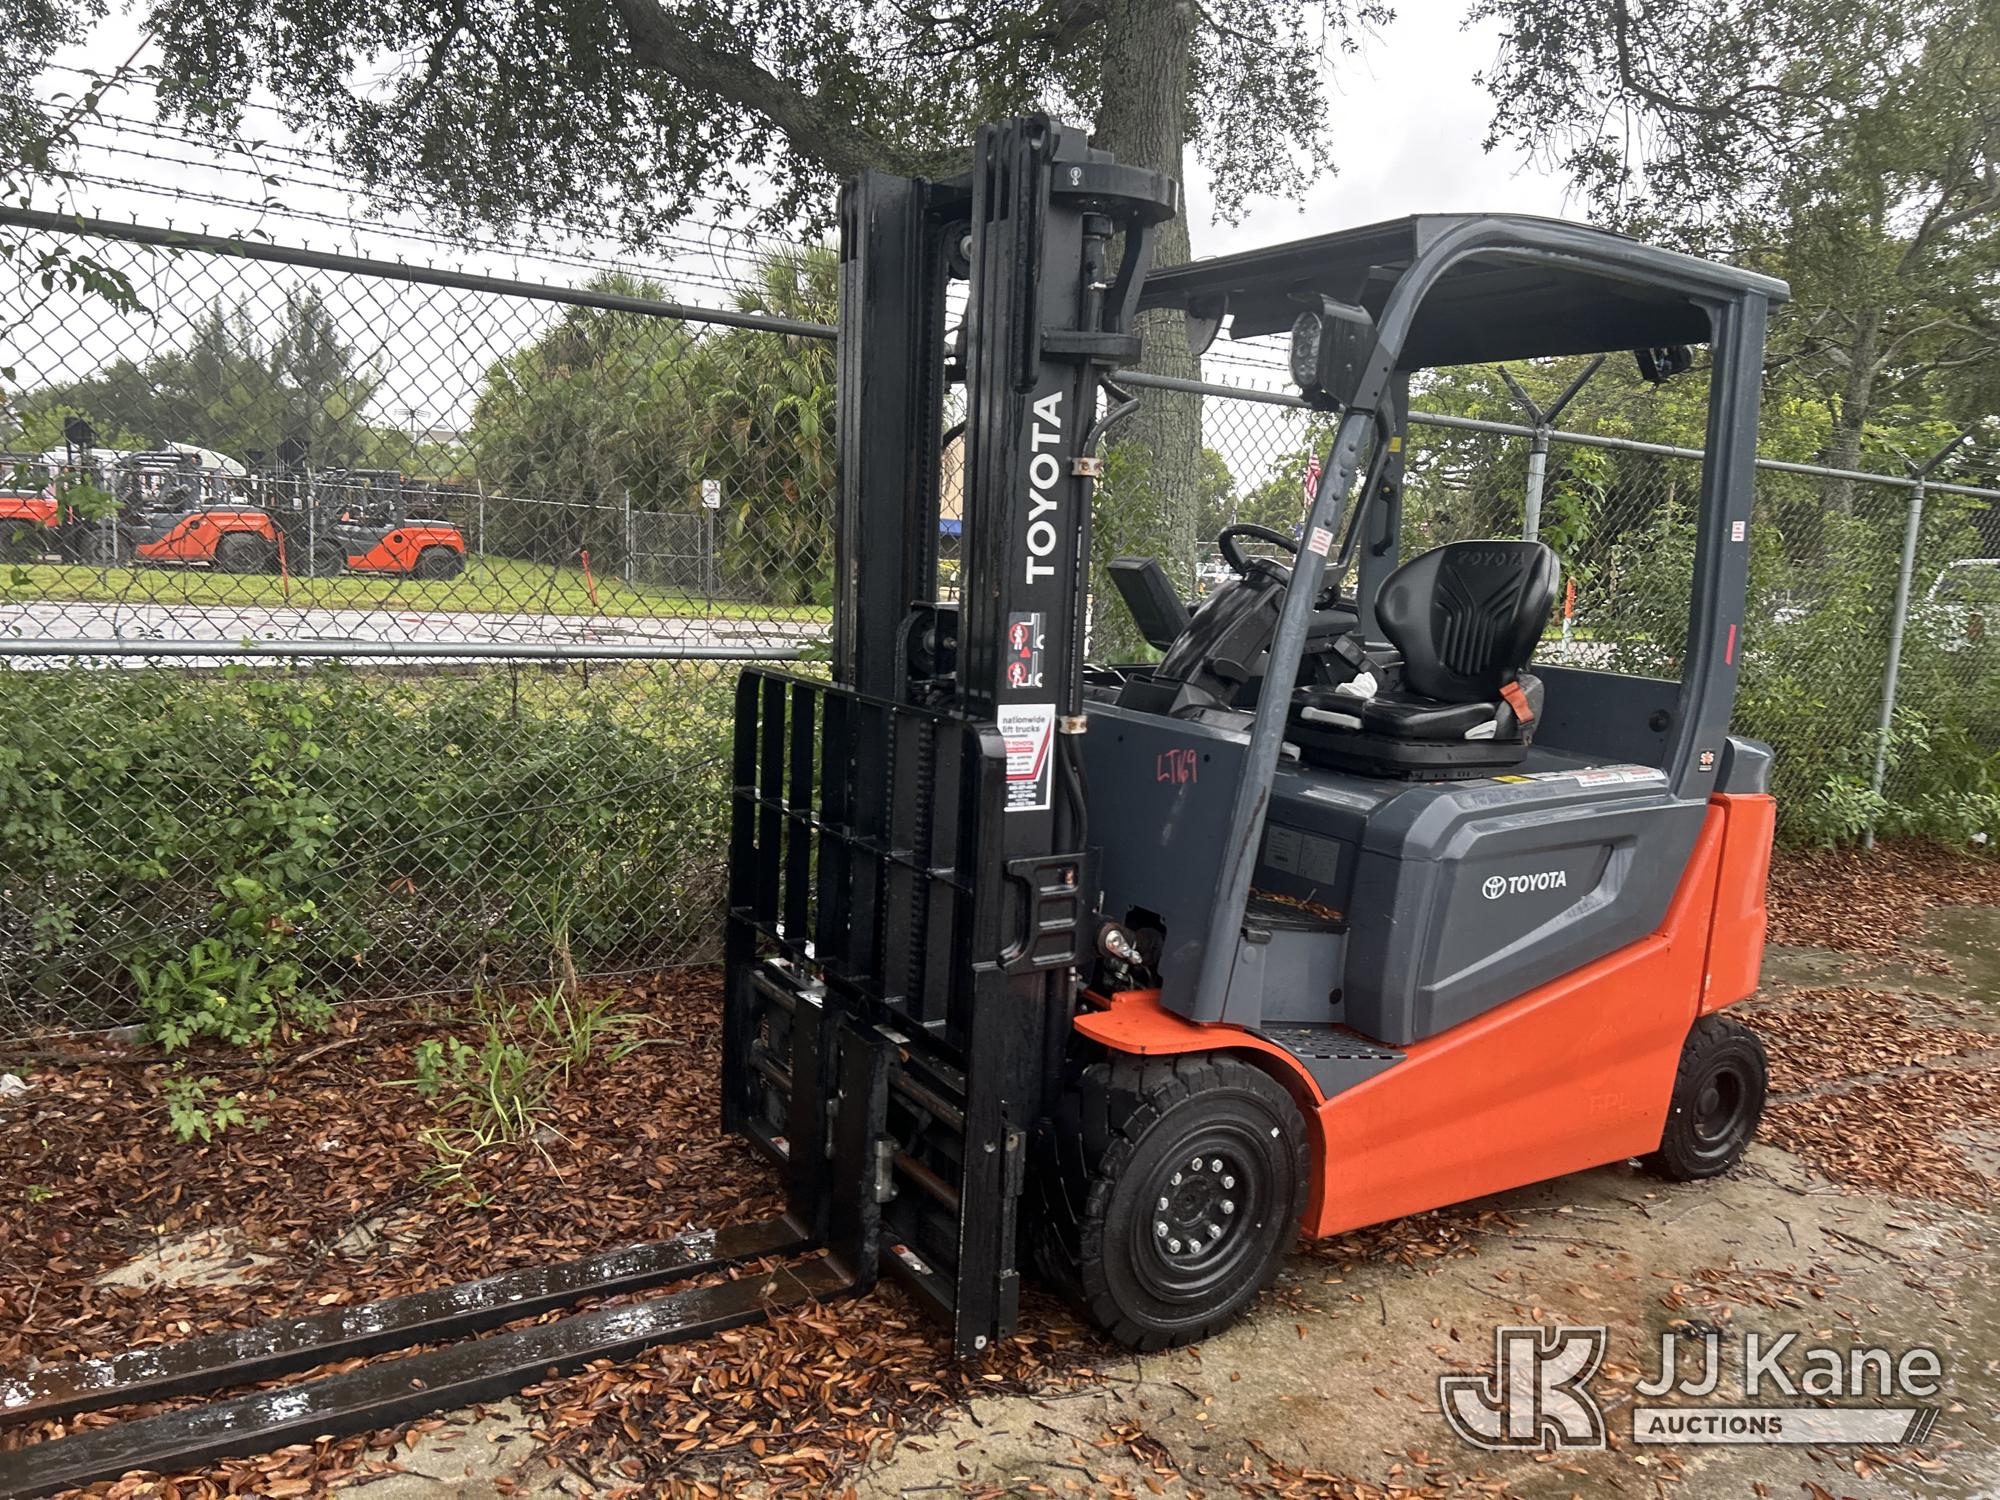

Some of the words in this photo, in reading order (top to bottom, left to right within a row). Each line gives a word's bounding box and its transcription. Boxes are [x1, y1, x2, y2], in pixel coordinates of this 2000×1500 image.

[1026, 391, 1062, 584] TOYOTA
[1458, 551, 1525, 567] TOYOTA
[1016, 725, 1040, 733] trucks
[1508, 871, 1567, 894] TOYOTA
